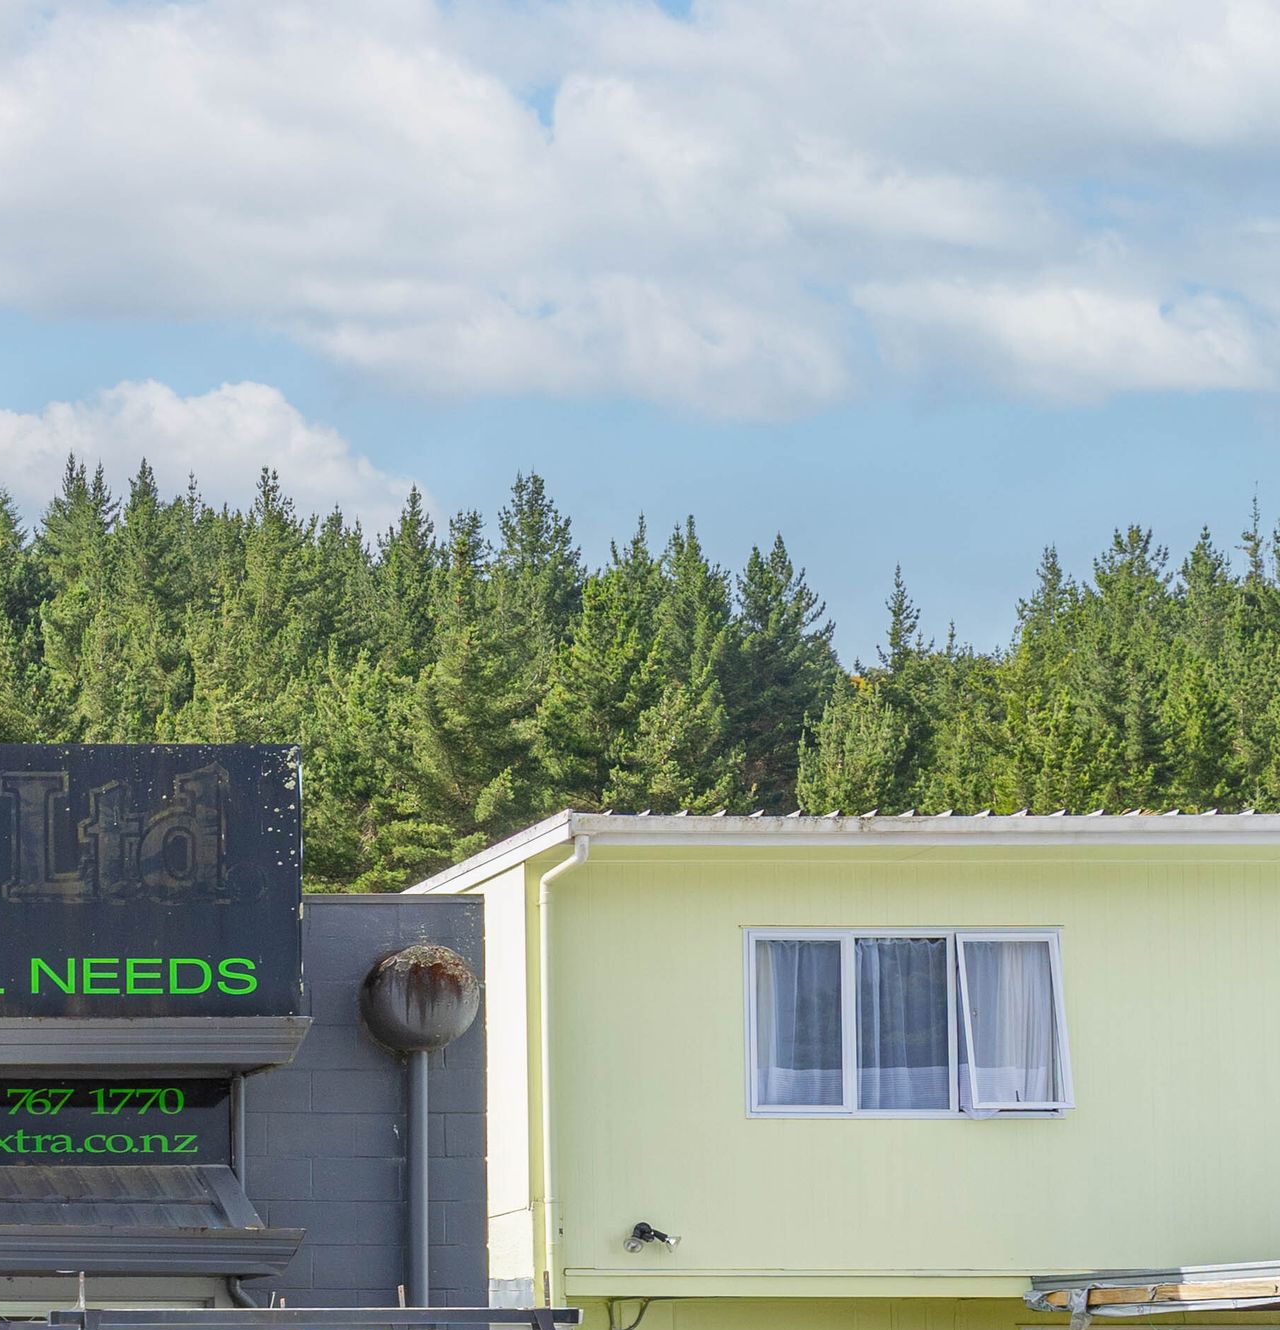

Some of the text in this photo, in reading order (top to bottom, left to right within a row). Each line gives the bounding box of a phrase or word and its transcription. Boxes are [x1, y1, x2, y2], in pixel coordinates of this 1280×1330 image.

[31, 957, 257, 995] NEEDS
[7, 1087, 75, 1115] 767
[93, 1087, 186, 1115] 1770
